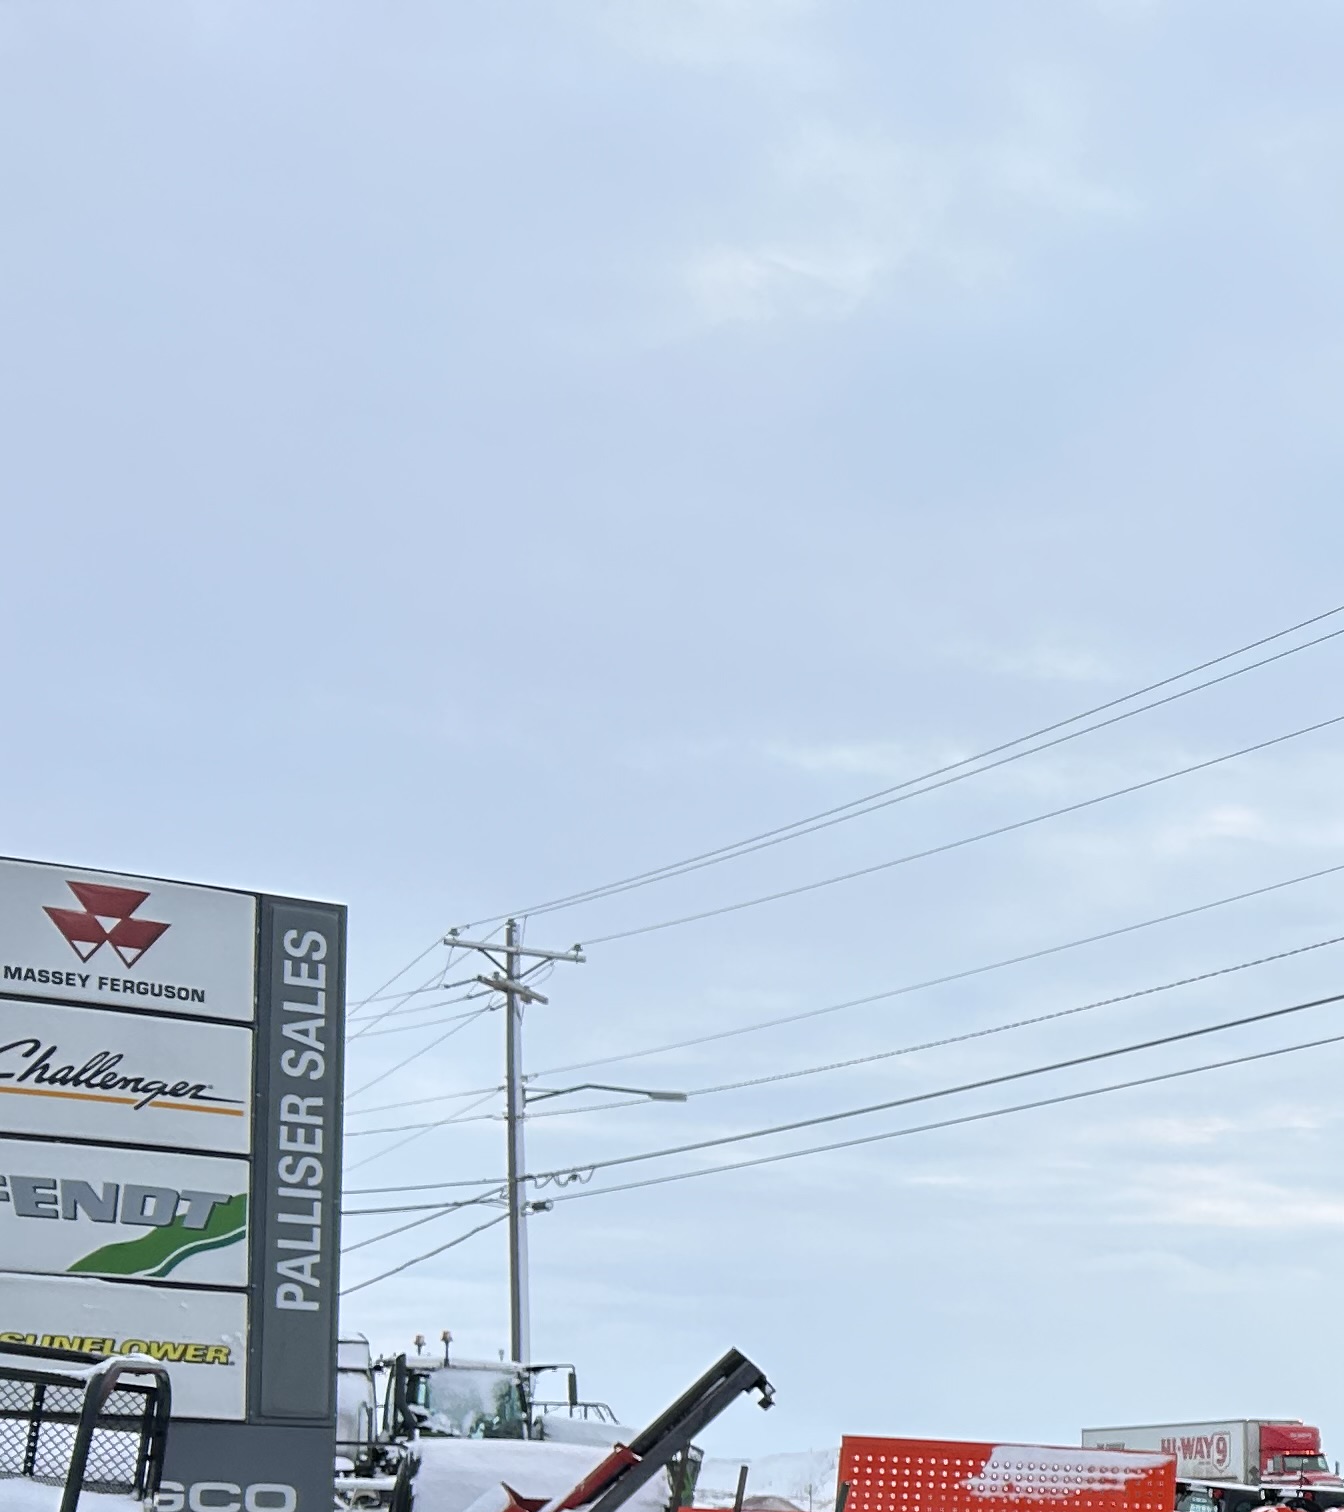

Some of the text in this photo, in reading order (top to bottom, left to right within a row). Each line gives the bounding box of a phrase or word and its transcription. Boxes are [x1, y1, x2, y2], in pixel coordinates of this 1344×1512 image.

[3, 966, 206, 1003] MASSEY FERGUSON
[275, 928, 328, 1312] PALLISER SALES
[0, 1174, 232, 1231] ENDT
